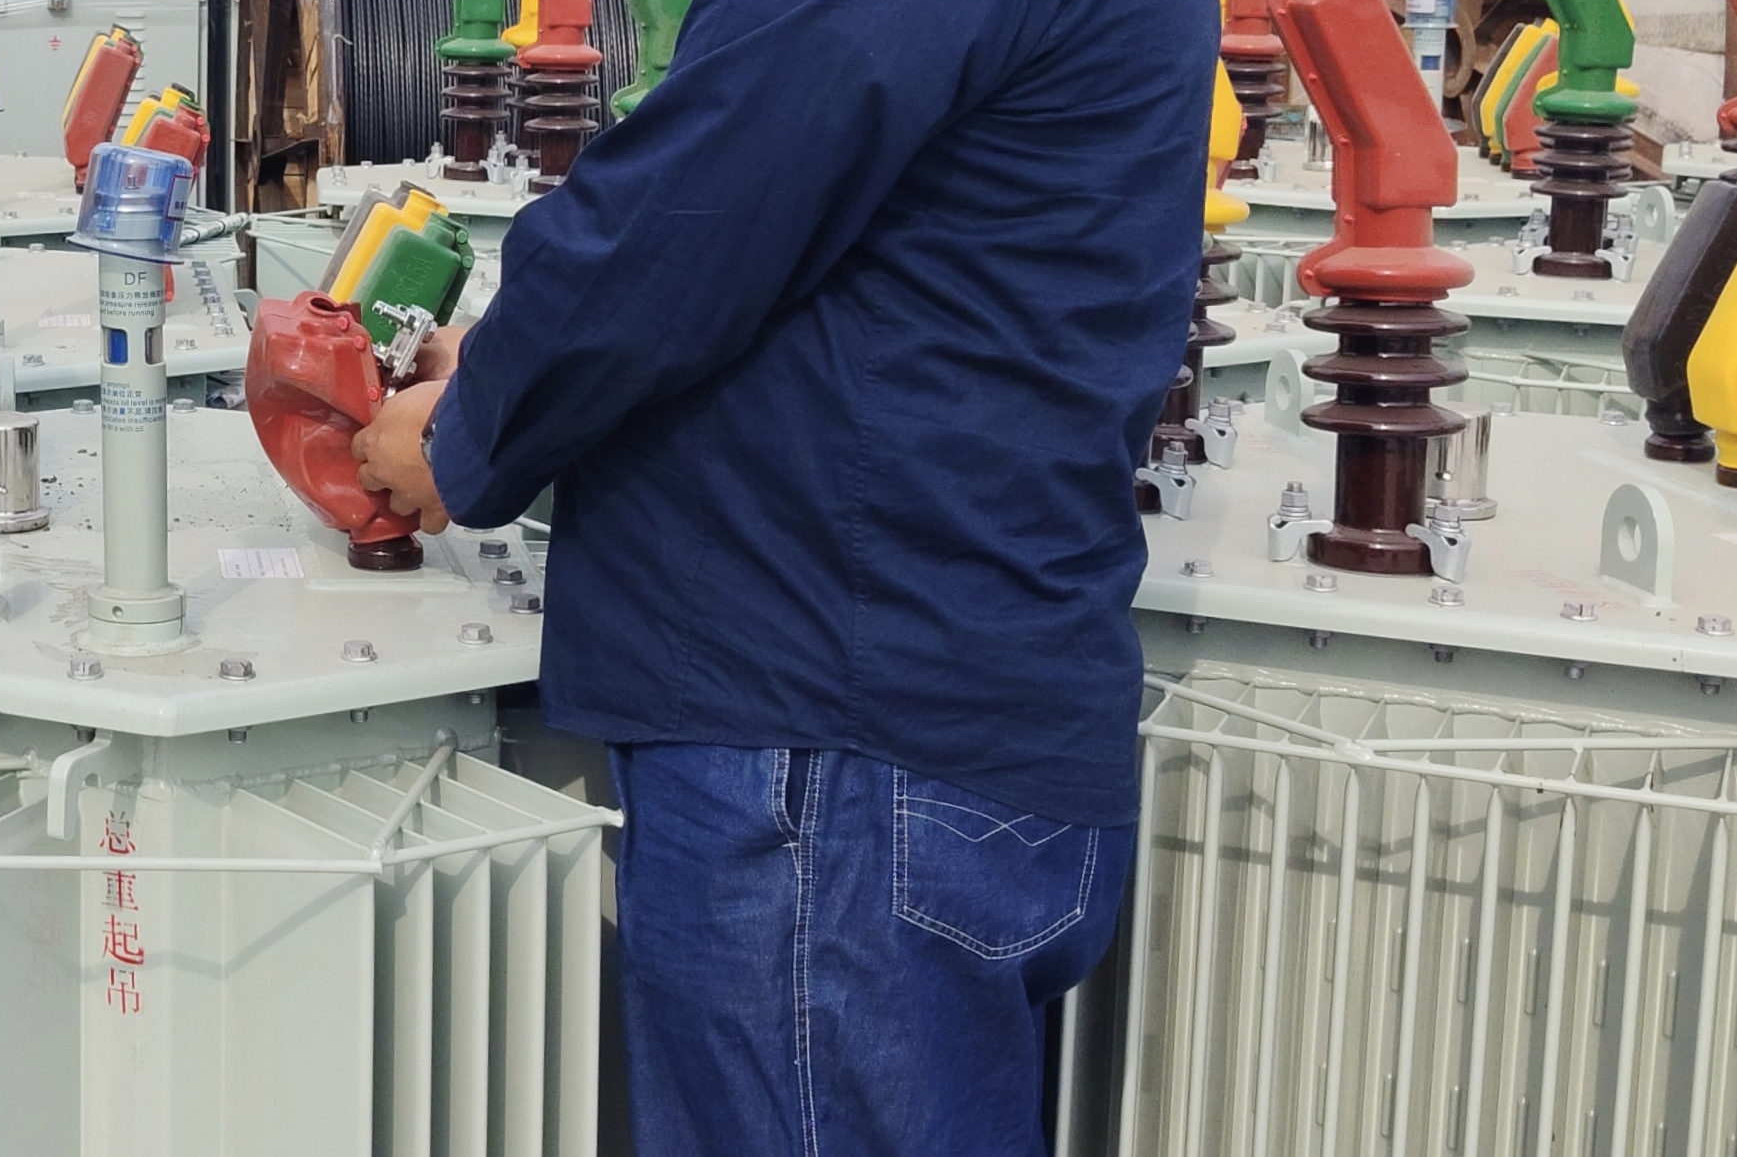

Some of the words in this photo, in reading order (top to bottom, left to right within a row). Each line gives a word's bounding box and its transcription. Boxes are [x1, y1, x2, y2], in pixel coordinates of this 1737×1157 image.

[124, 271, 148, 286] DF
[98, 809, 145, 1015] 总重起吊
